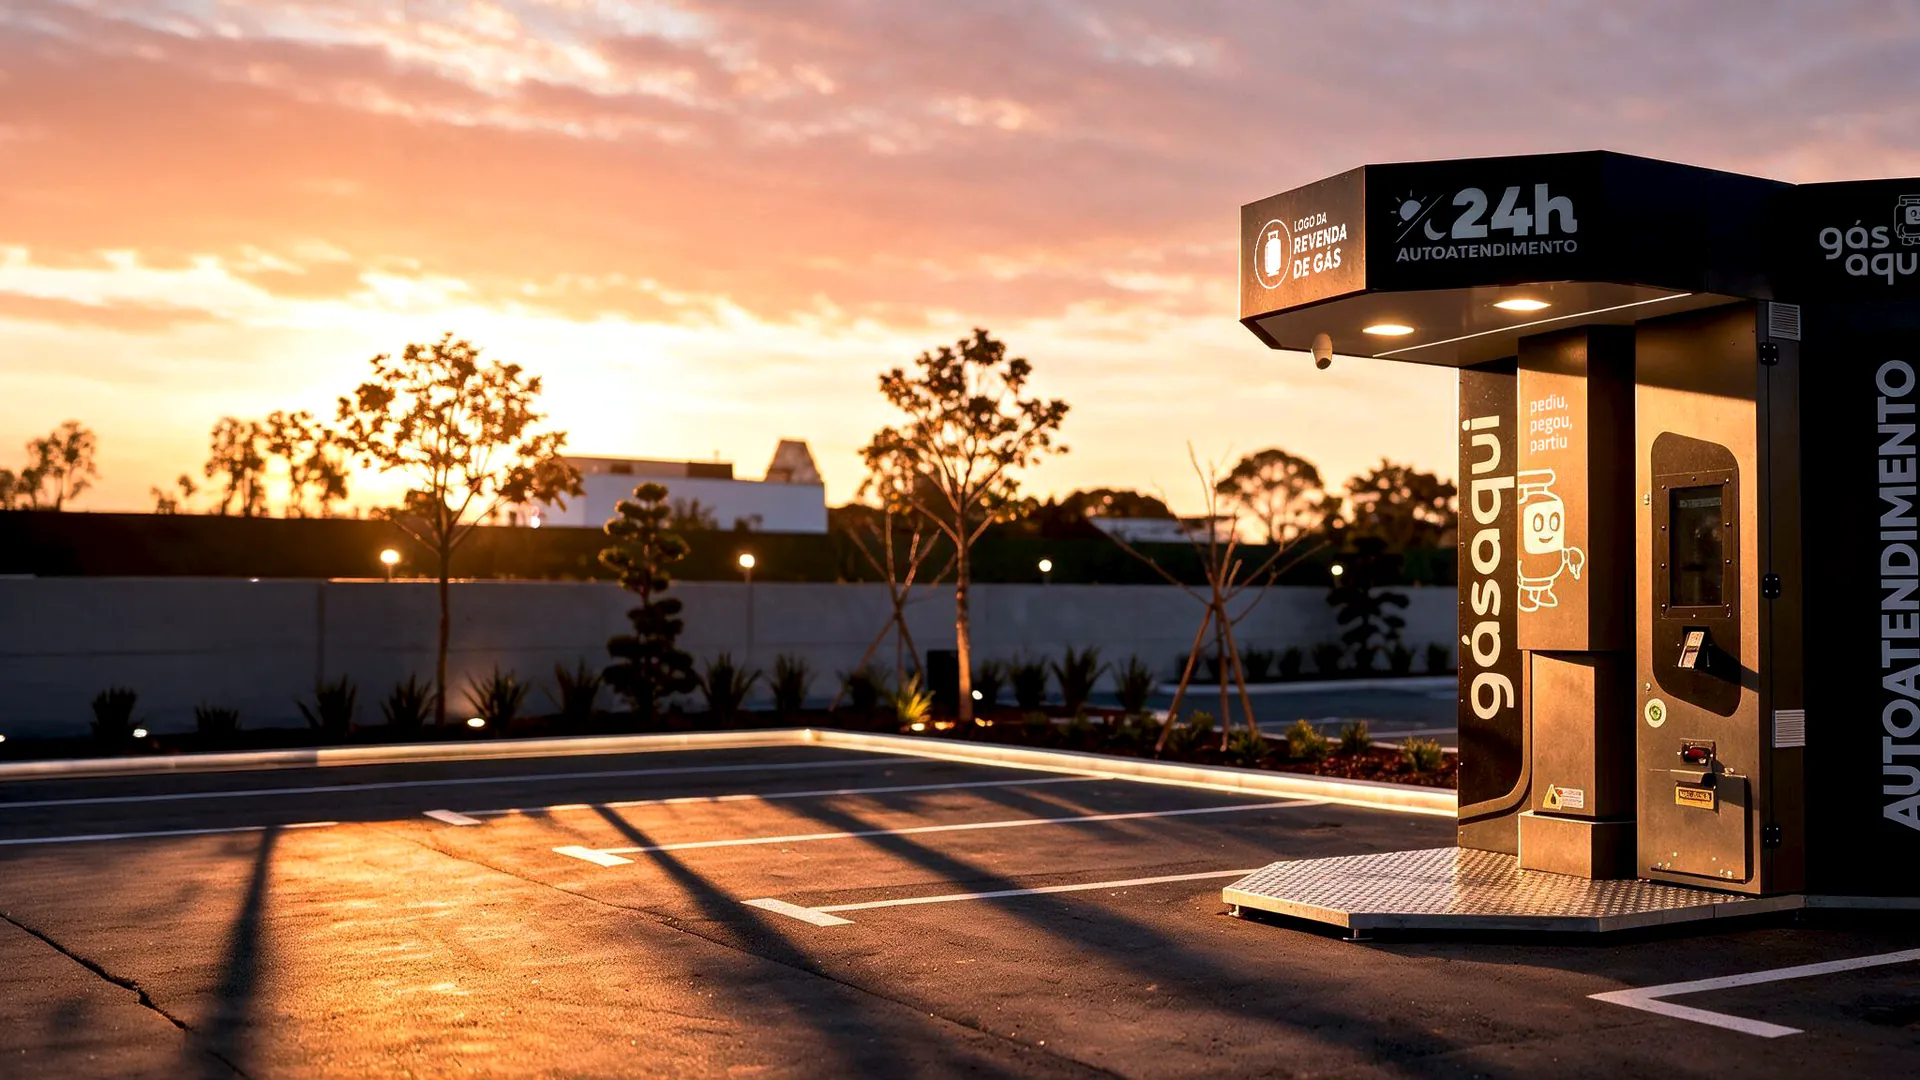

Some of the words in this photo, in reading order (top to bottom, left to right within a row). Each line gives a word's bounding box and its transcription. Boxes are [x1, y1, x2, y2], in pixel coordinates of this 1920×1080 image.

[1294, 215, 1315, 233] LOGO
[1316, 212, 1327, 226] DA
[1451, 183, 1578, 239] 24h
[1293, 223, 1348, 255] REVENDA
[1396, 239, 1578, 262] AUTOATENDIMENTO
[1819, 219, 1890, 260] gás
[1293, 257, 1311, 280] DE
[1313, 245, 1342, 274] GÁS
[1845, 253, 1918, 285] aqu
[1530, 394, 1569, 417] pediu,
[1530, 415, 1573, 436] pegou,
[1530, 433, 1568, 455] partiu
[1461, 415, 1515, 720] gásaqui
[1875, 359, 1920, 832] AUTOATENDIMENTO
